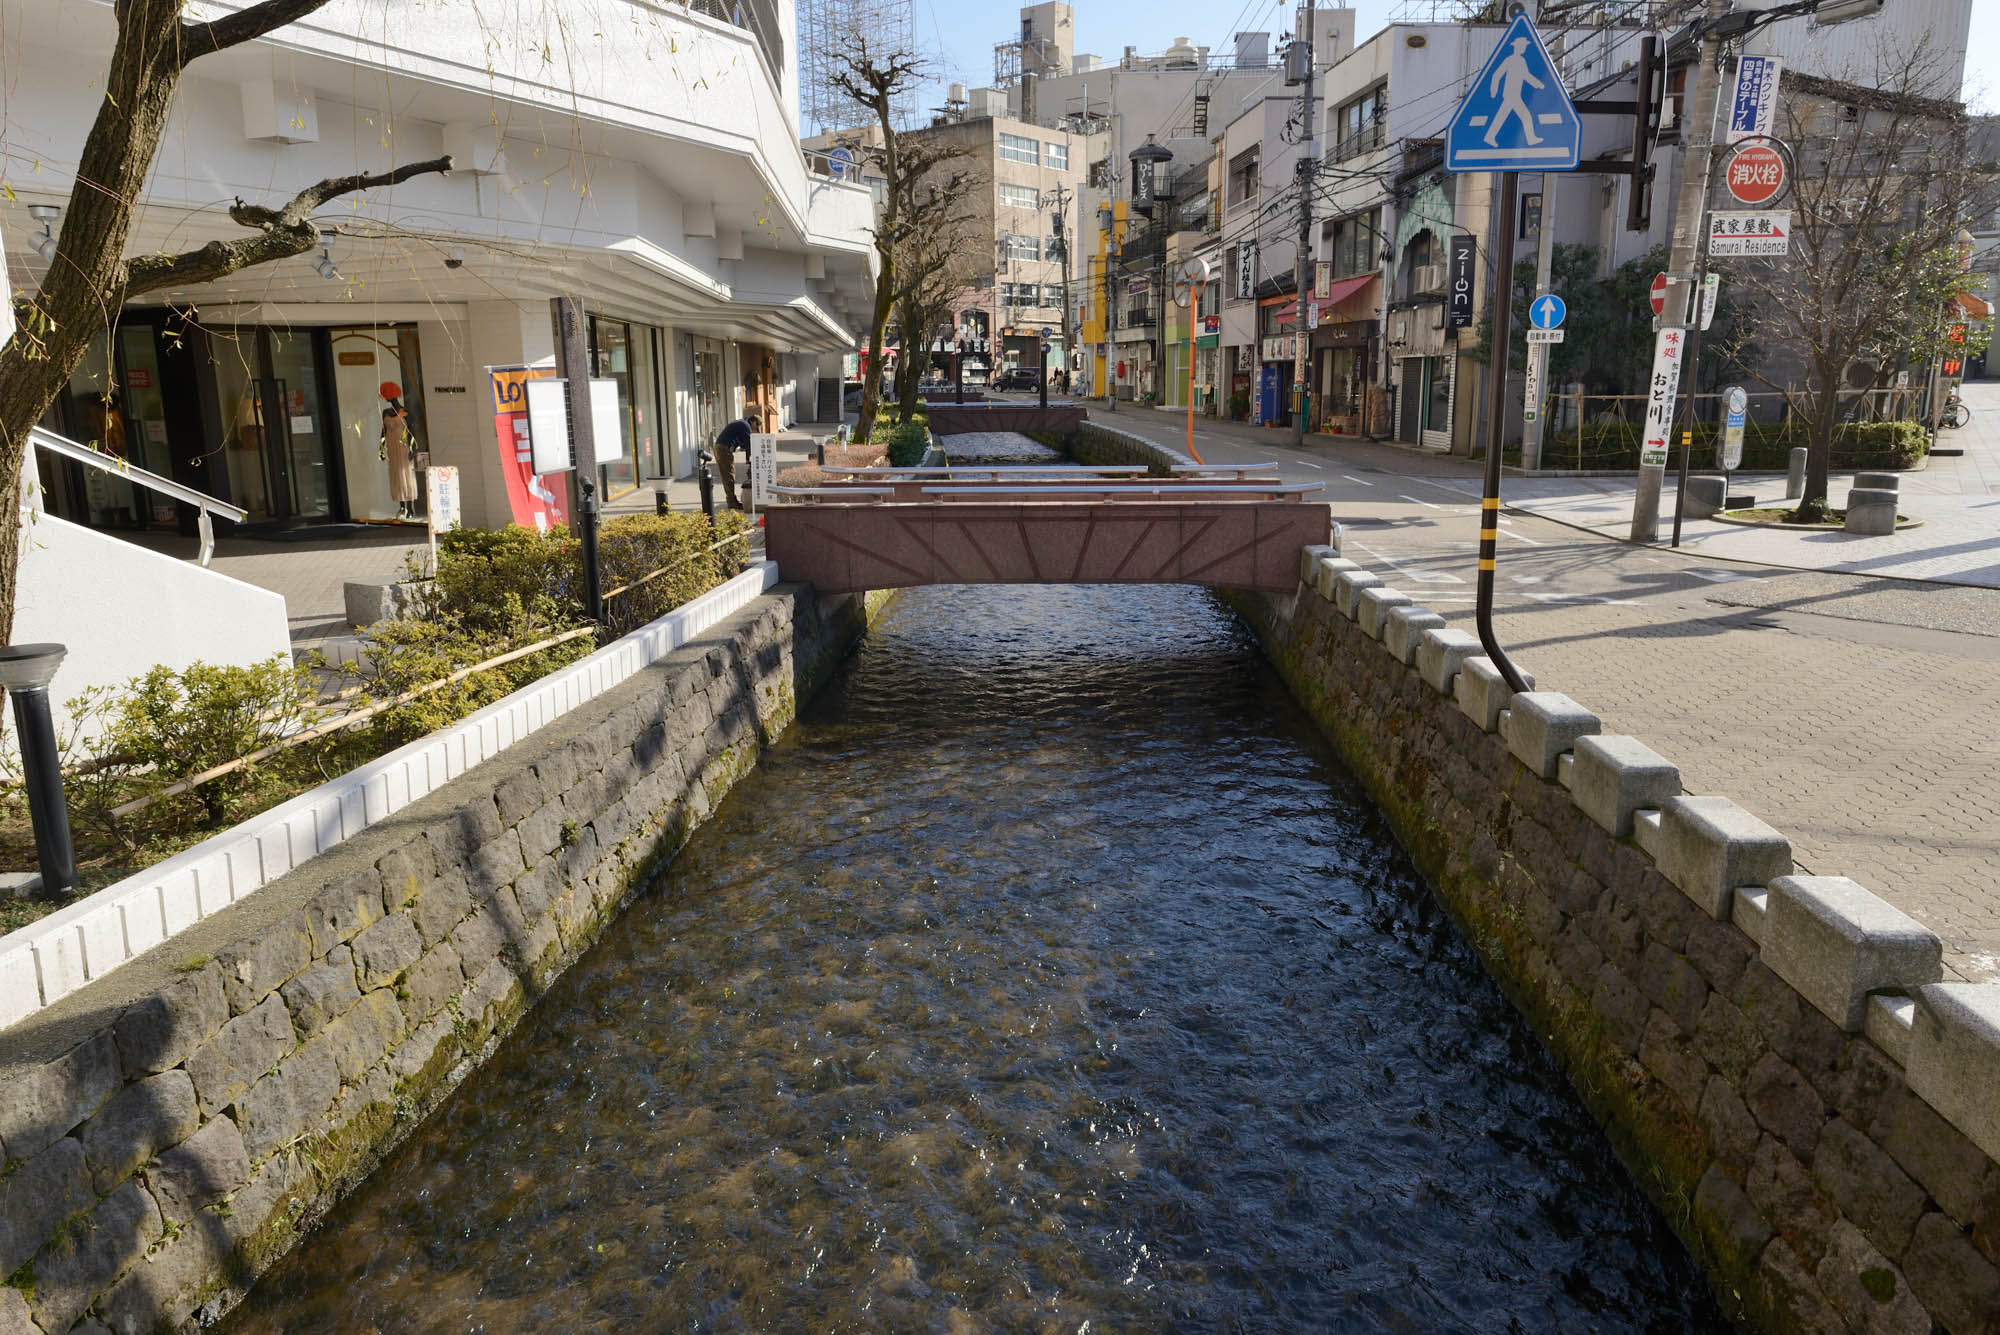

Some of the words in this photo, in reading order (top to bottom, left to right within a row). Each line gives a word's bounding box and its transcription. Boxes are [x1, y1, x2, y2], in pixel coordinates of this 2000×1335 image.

[1734, 60, 1755, 131] 四季のテーブル
[1756, 61, 1775, 132] 青木クッキング
[1732, 163, 1779, 185] 消火栓
[1712, 218, 1772, 234] 武家屋敷
[1711, 240, 1742, 254] Samurai
[1744, 239, 1786, 253] Residence
[1663, 332, 1679, 358] 味処
[1944, 324, 1966, 377] 営中
[1649, 372, 1668, 425] おと川
